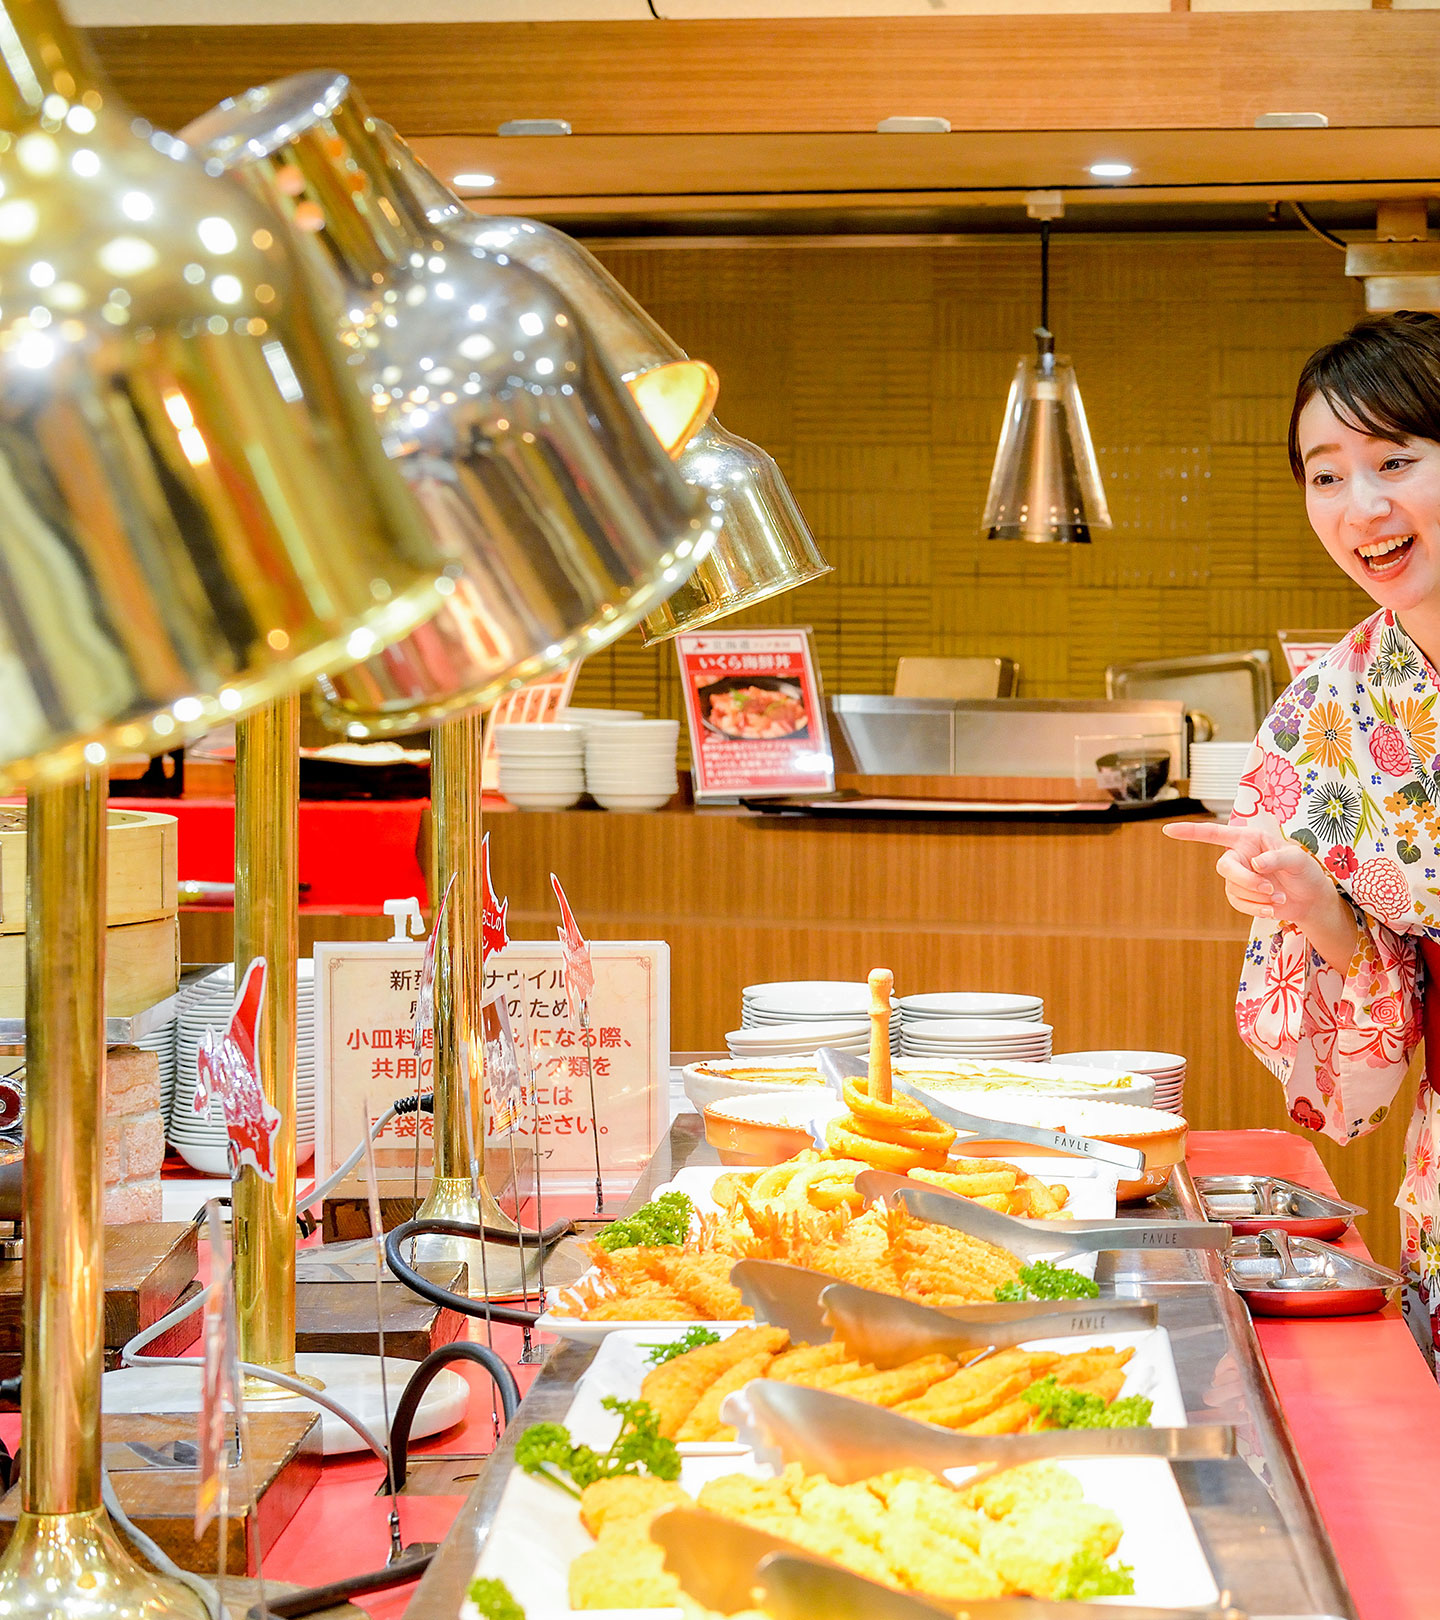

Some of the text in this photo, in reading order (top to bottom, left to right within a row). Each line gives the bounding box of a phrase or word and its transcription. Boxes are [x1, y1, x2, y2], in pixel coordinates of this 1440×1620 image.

[1054, 1135, 1089, 1152] FAVLE
[1142, 1232, 1177, 1244] FAVLE
[1071, 1315, 1106, 1330] FAVLE
